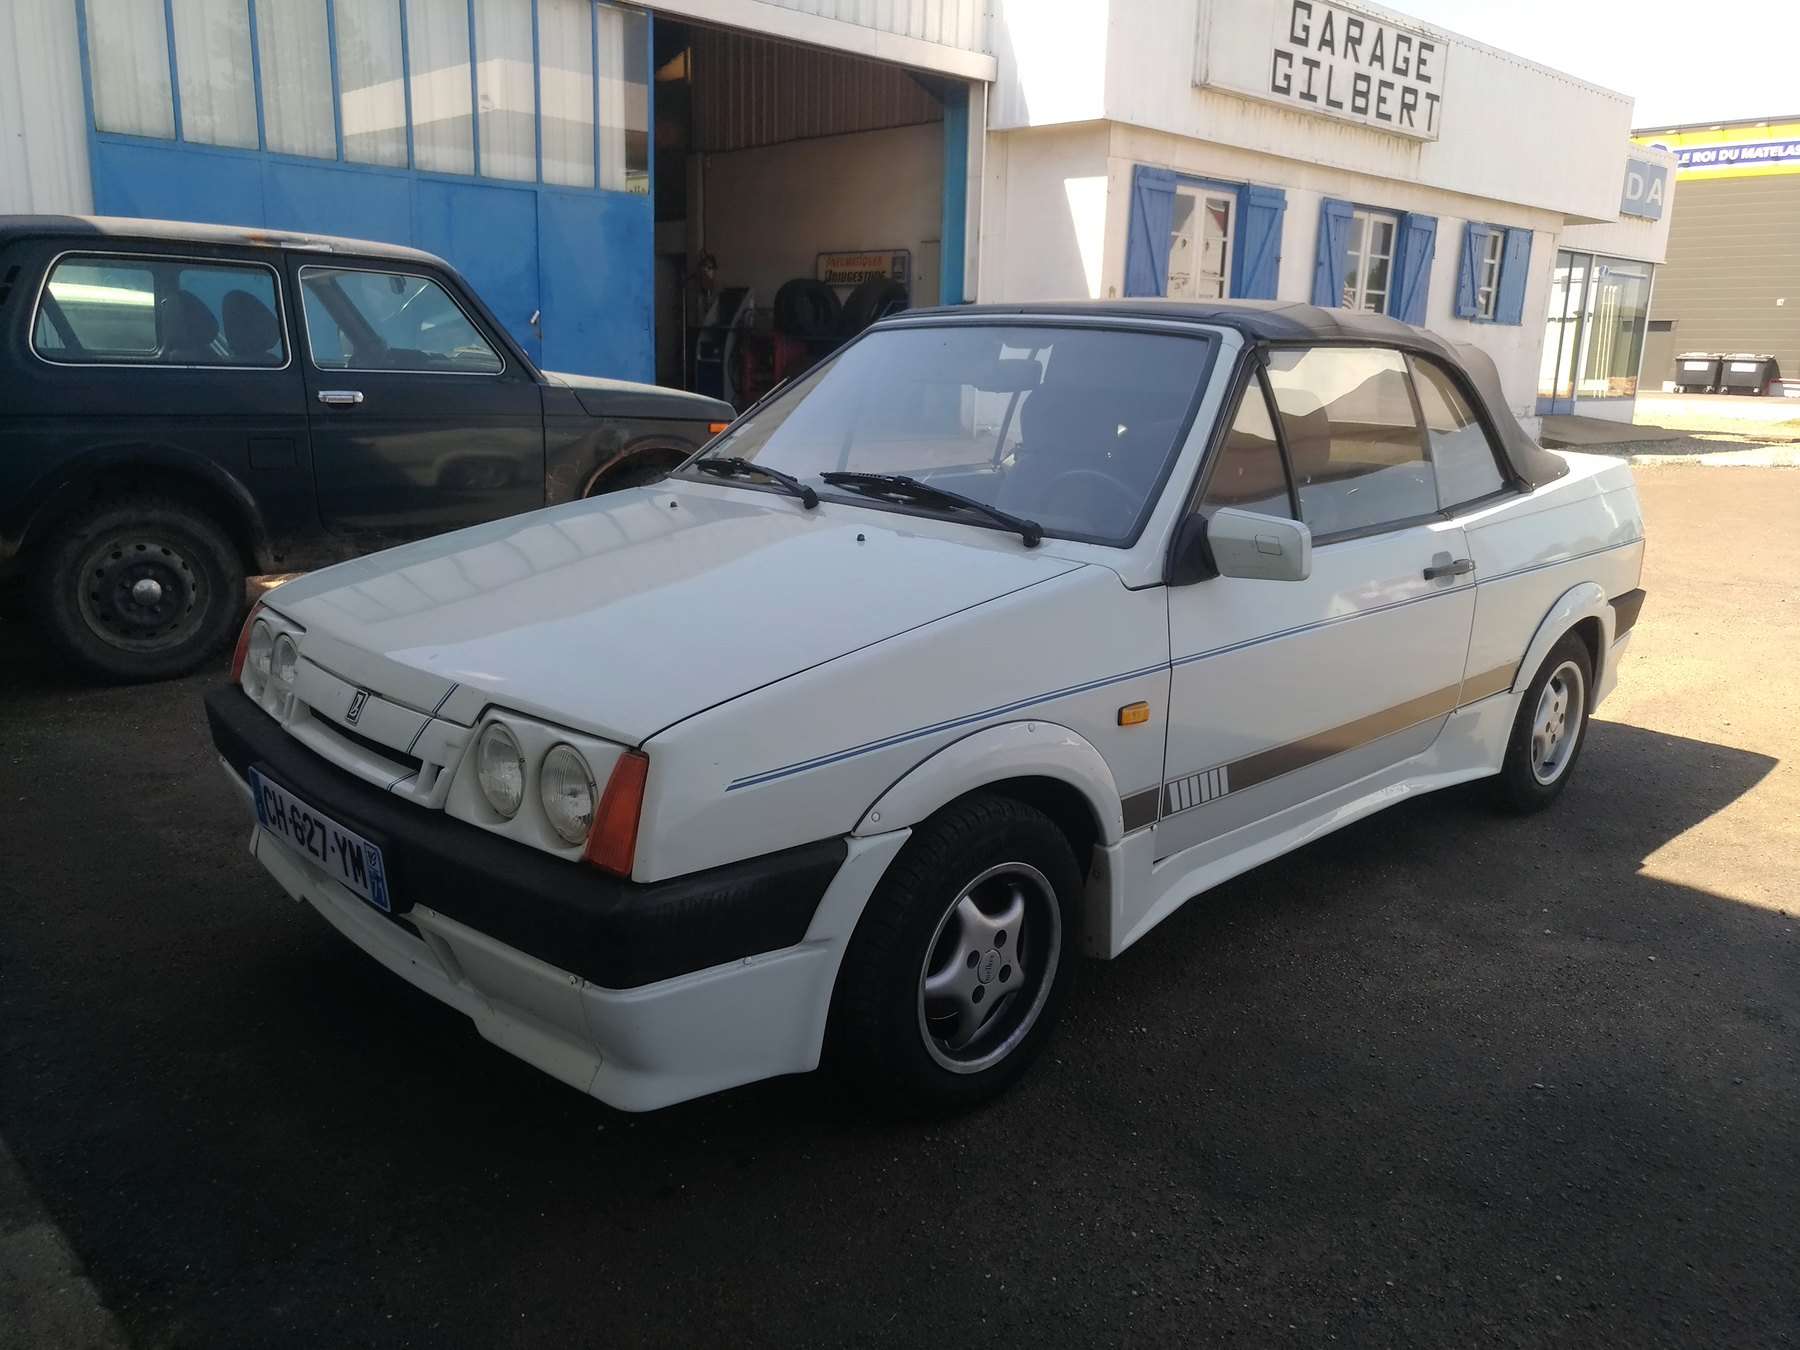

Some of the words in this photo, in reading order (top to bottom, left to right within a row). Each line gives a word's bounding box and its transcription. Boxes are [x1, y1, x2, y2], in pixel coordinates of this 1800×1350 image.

[1289, 0, 1434, 84] GARAGE
[1271, 48, 1440, 131] GILBERT
[1692, 150, 1717, 163] ROI
[1718, 148, 1739, 161] DU
[1625, 172, 1663, 207] DA
